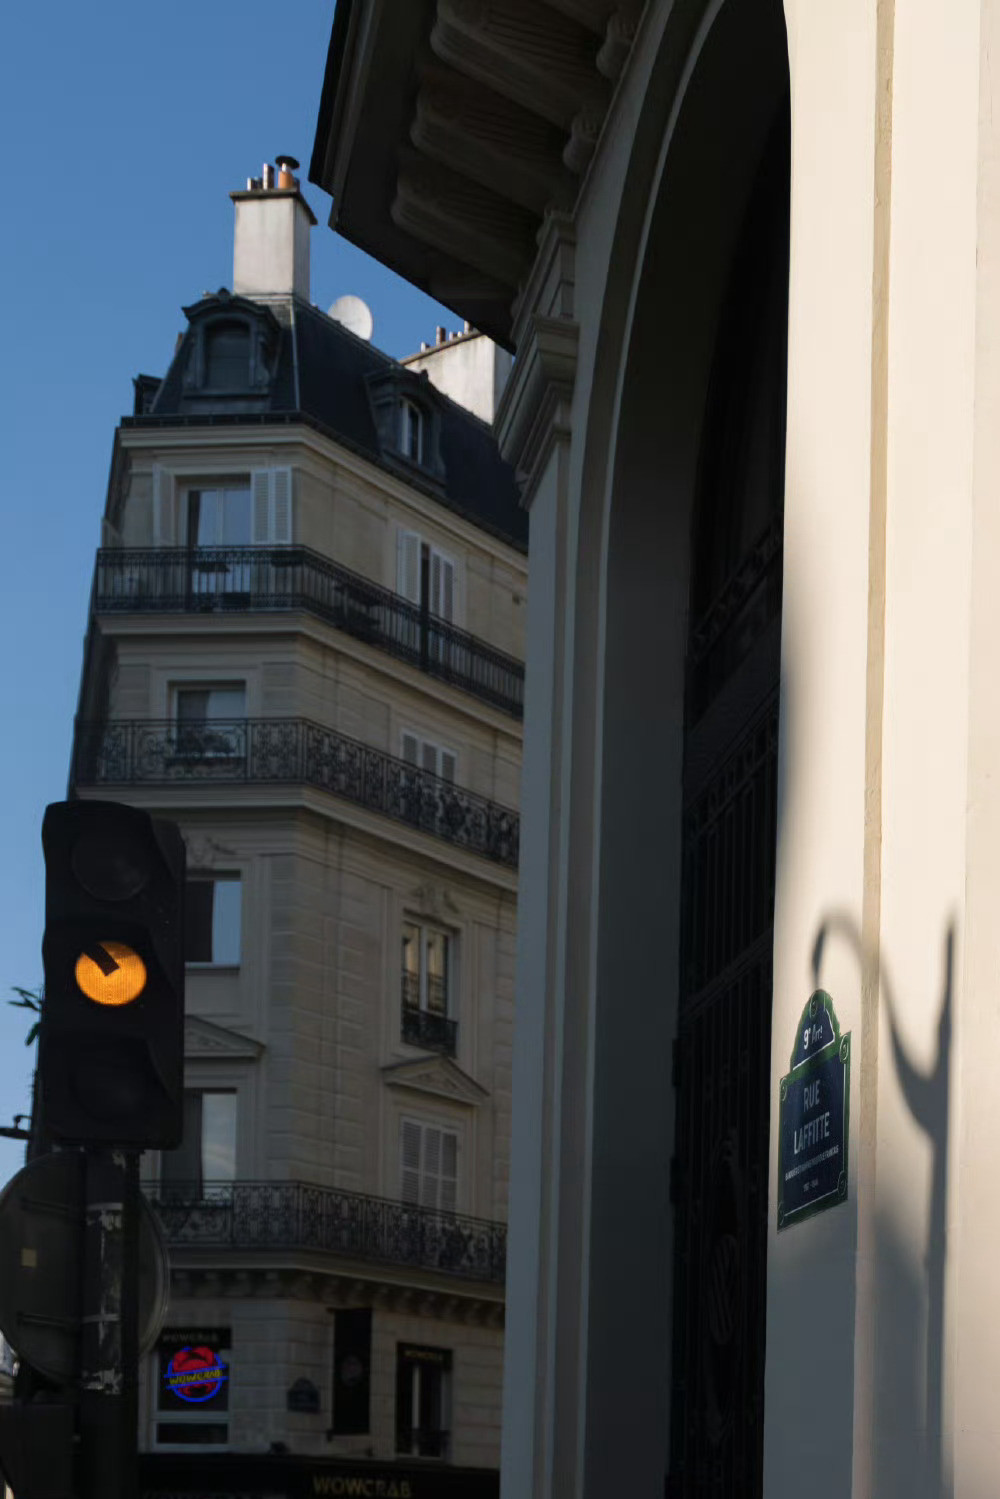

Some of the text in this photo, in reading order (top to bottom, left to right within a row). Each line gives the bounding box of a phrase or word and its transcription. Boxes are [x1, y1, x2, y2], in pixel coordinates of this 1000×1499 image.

[803, 1079, 820, 1112] RUE
[793, 1111, 830, 1155] LAFFITTE
[312, 1475, 412, 1499] WOWCRAB
